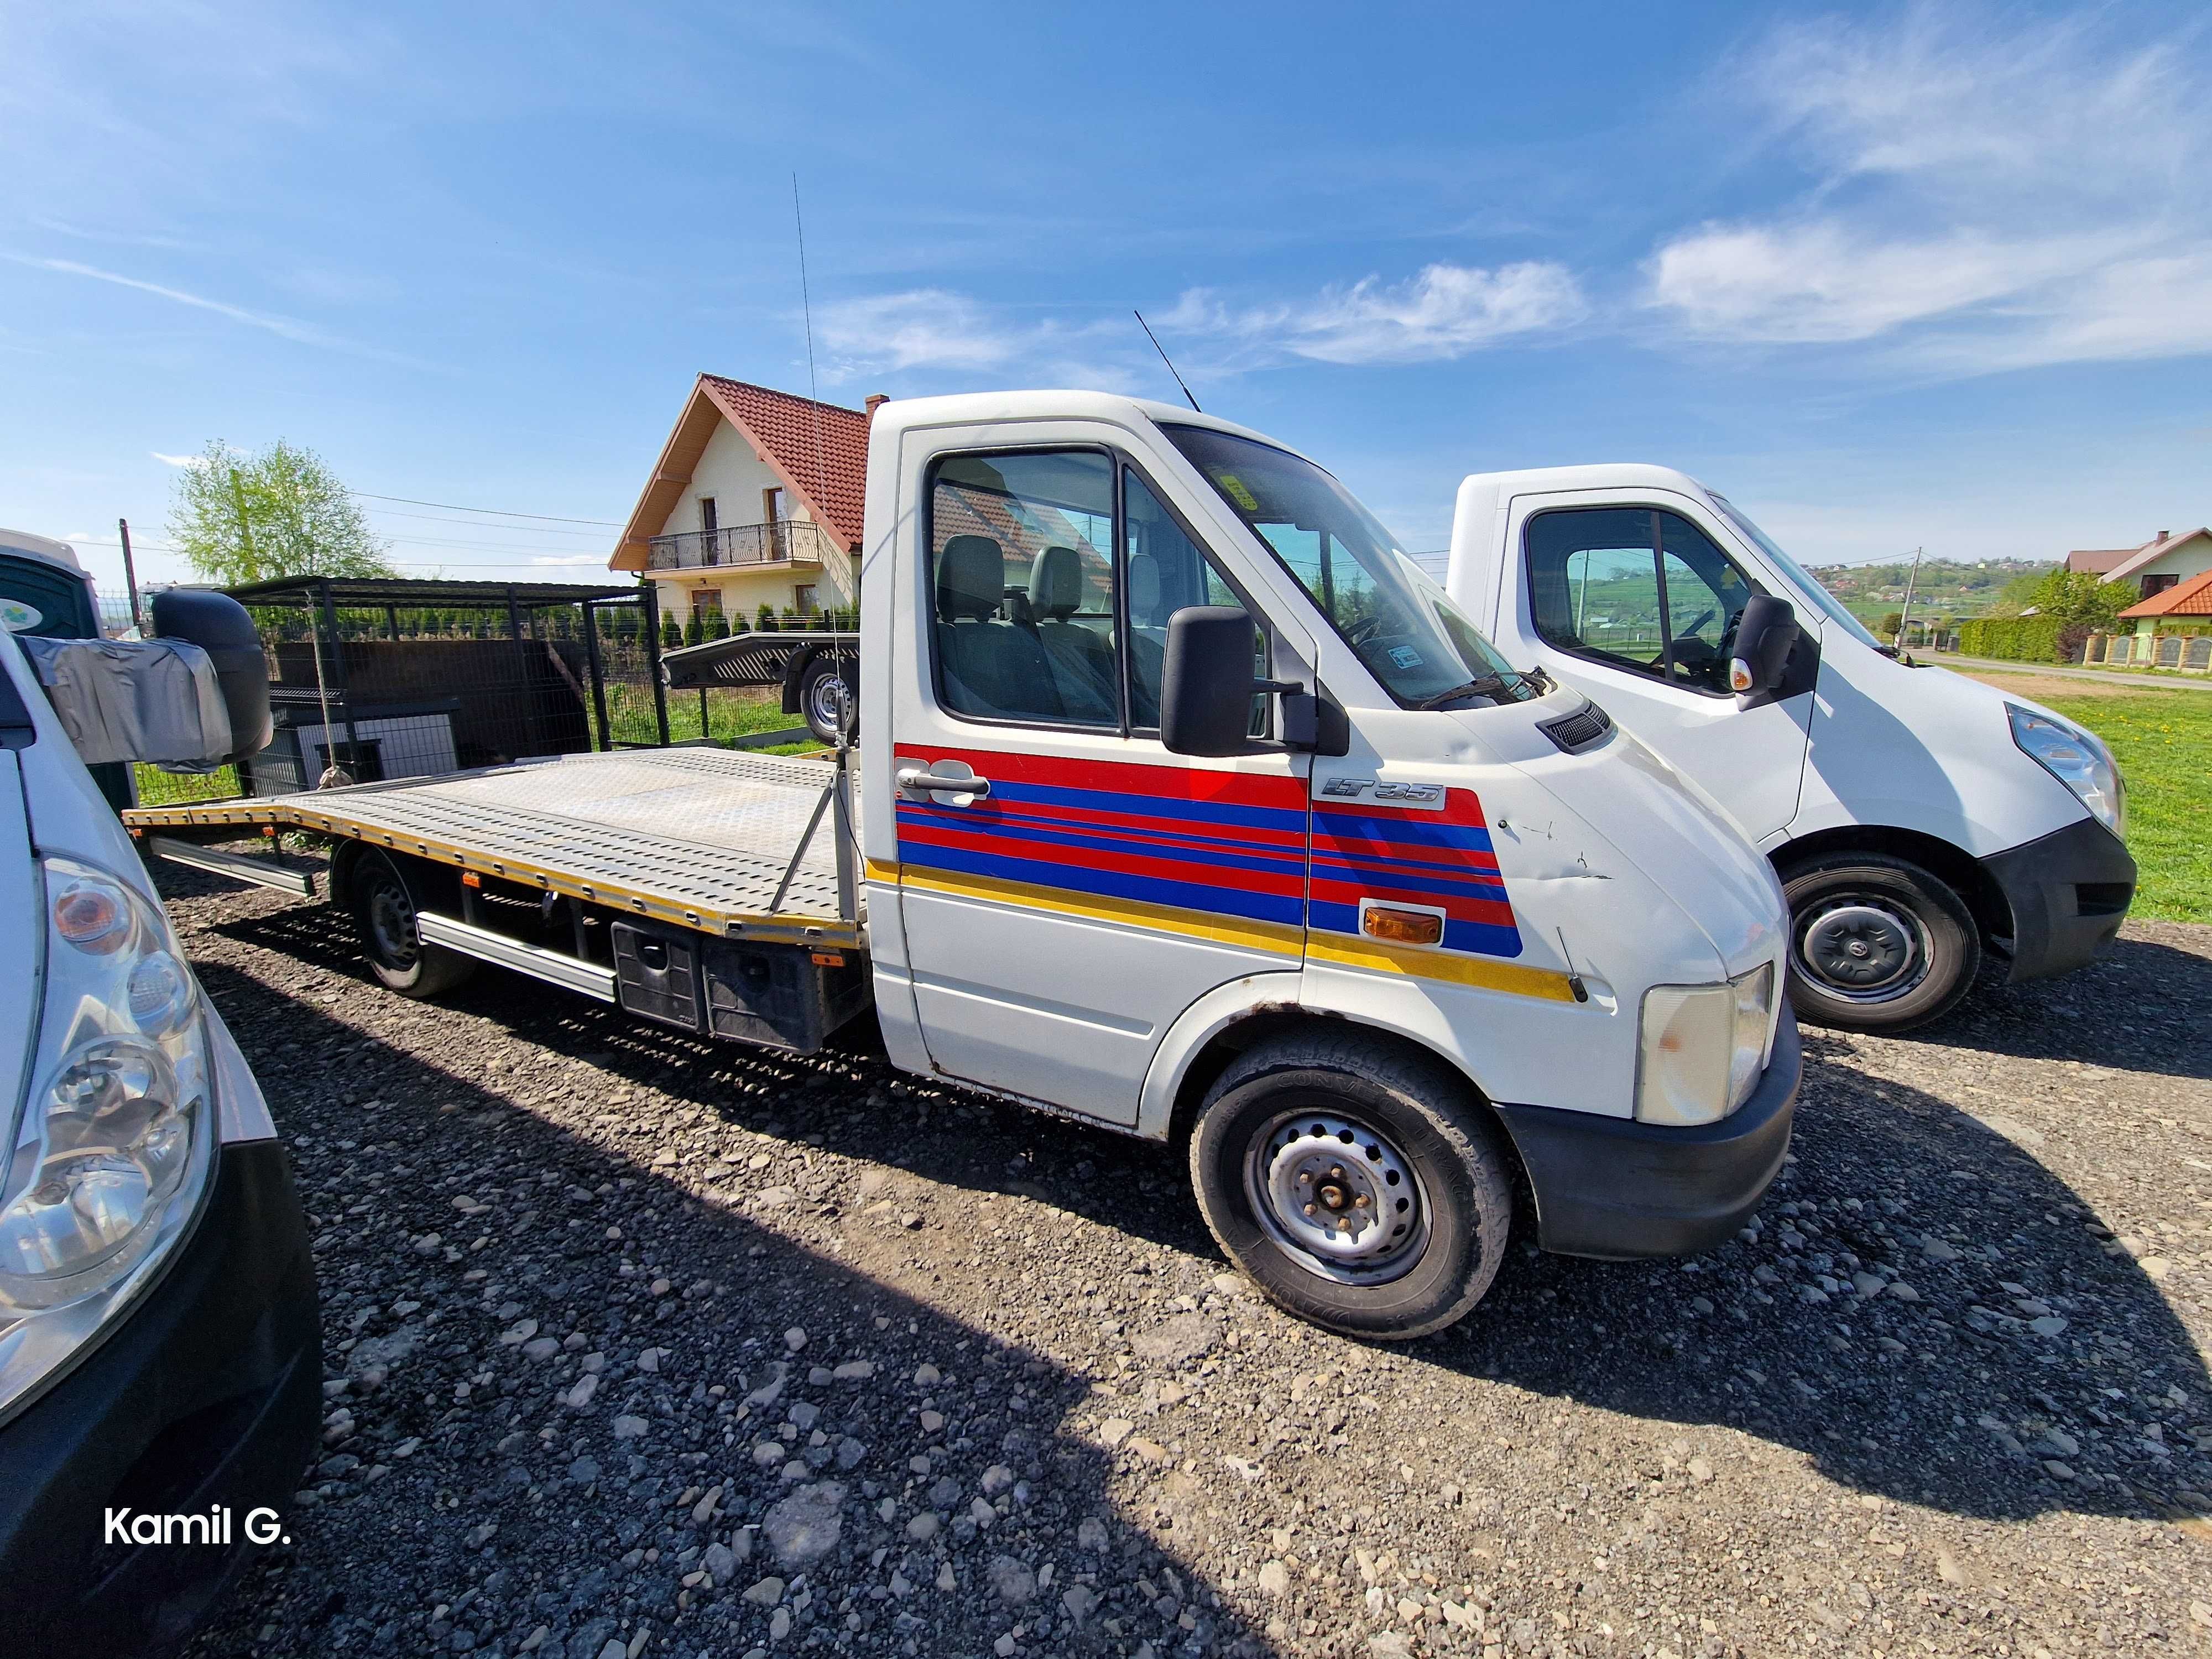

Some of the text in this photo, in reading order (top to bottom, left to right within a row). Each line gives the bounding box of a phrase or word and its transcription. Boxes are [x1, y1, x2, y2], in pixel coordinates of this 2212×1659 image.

[1321, 778, 1444, 801] LT 35
[1276, 1072, 1399, 1115] CONVEO
